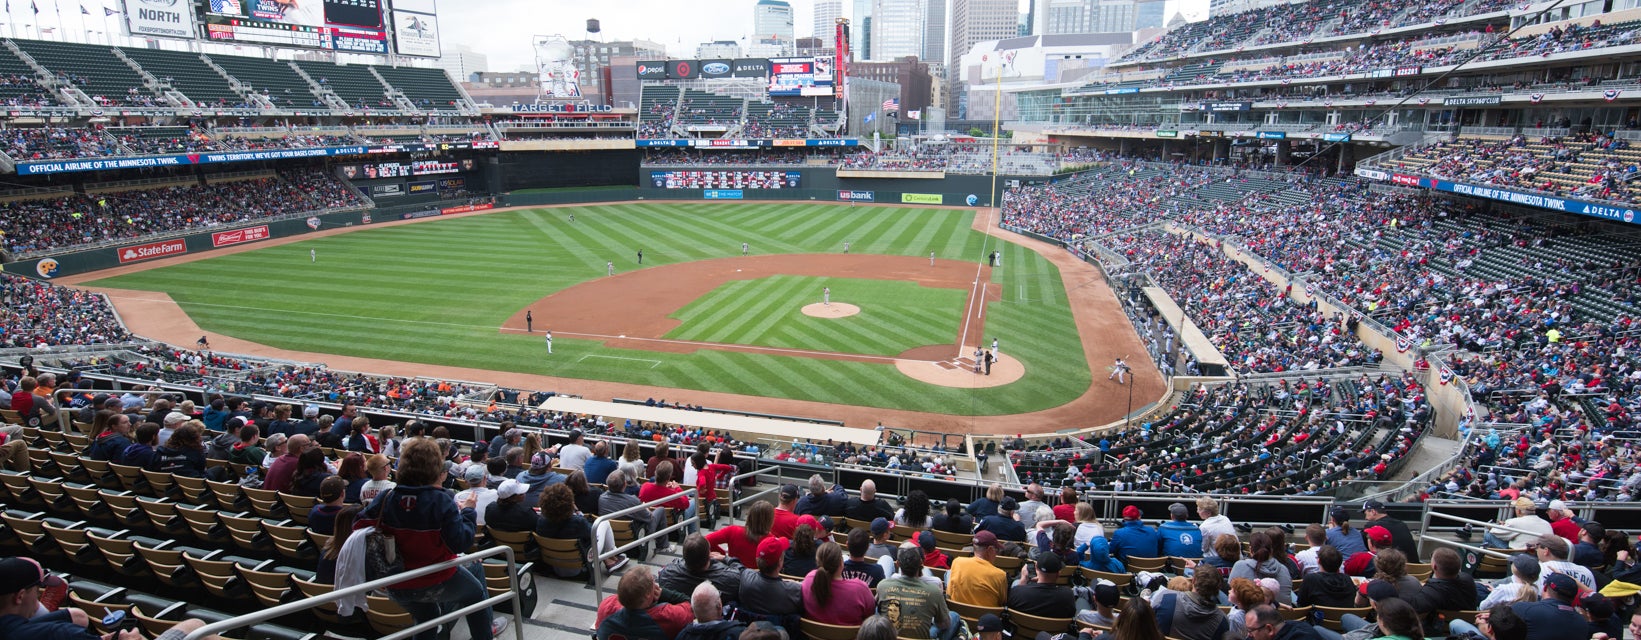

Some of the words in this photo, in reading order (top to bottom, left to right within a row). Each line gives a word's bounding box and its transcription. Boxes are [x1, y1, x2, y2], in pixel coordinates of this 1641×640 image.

[139, 8, 180, 23] NORTH
[647, 65, 664, 73] pepsi
[512, 104, 563, 112] TARGET
[577, 104, 613, 112] FIELD
[29, 163, 63, 173] OFFICIAL
[64, 161, 92, 170] AIRLINE
[105, 159, 118, 168] THE
[119, 158, 156, 168] MINNESOTA
[411, 184, 434, 192] SUBWAY
[1454, 184, 1473, 194] OFFICIAL
[1473, 186, 1491, 197] AIRLINE
[1491, 189, 1499, 198] OF
[1500, 190, 1510, 200] THE
[1510, 192, 1542, 206] MINNESOTA
[1543, 197, 1566, 210] TWINS.
[1592, 206, 1620, 218] DELTA
[842, 570, 873, 586] UXTON
